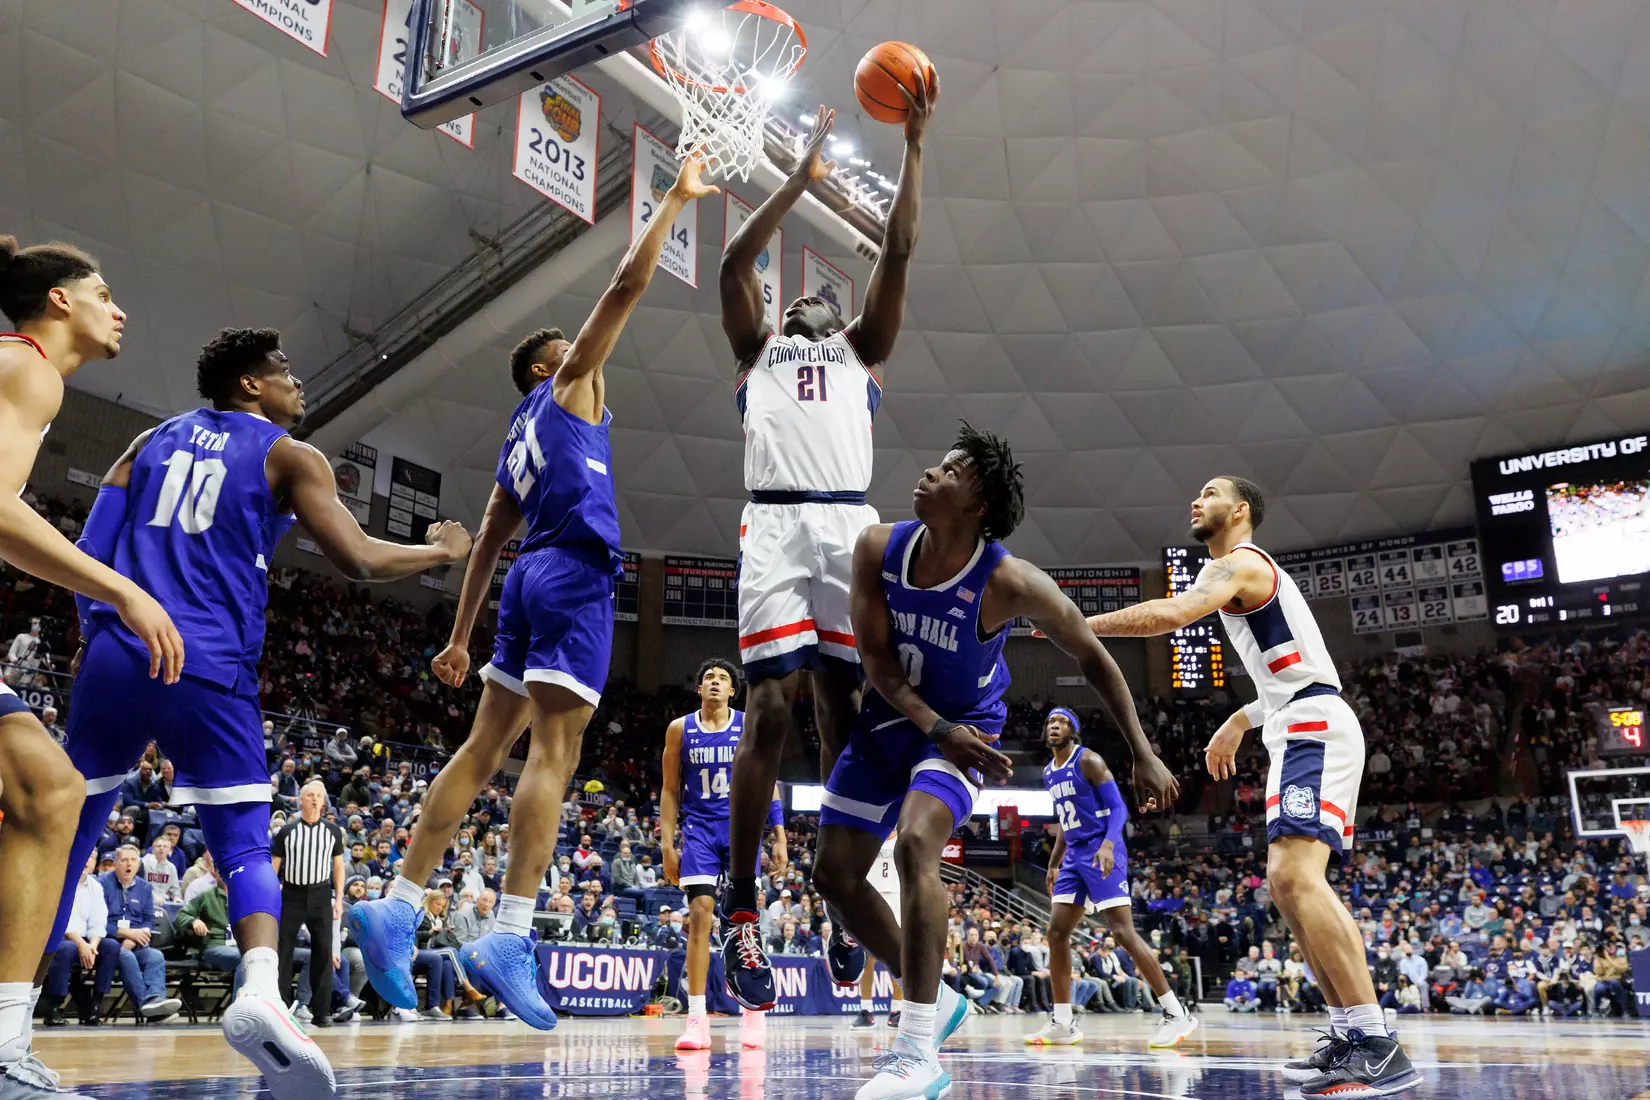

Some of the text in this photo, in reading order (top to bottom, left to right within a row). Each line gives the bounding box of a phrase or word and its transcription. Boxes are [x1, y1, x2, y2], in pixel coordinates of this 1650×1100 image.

[529, 127, 585, 181] 2013
[529, 156, 582, 196] NATIONAL
[524, 168, 585, 213] CHAMPIONS
[641, 201, 689, 249] 214
[797, 365, 828, 402] 21
[1499, 436, 1648, 475] UNIVERSITY OF
[145, 449, 228, 535] 10
[1488, 489, 1534, 506] WELLS
[1491, 500, 1535, 516] FARGO
[1311, 544, 1356, 558] HUSKIES
[1361, 542, 1373, 550] OF
[1379, 536, 1415, 548] HONOR
[1453, 556, 1478, 572] 42
[1502, 558, 1539, 576] CBS
[1352, 571, 1375, 586] 42
[1385, 566, 1408, 581] 44
[1320, 575, 1342, 591] 25
[1356, 610, 1379, 626] 24
[1392, 606, 1411, 621] 13
[1425, 602, 1447, 618] 22
[1496, 604, 1520, 625] 20
[890, 608, 917, 637] TON
[919, 614, 960, 653] HALL
[19, 689, 55, 708] 109
[304, 738, 320, 748] SEC
[1623, 727, 1641, 748] 4
[689, 746, 715, 764] SETON
[699, 767, 731, 800] 14
[1056, 800, 1082, 832] 22
[1375, 829, 1395, 840] 114
[882, 861, 889, 878] 2
[548, 951, 654, 991] UCONN
[560, 996, 634, 1009] BASKETBALL
